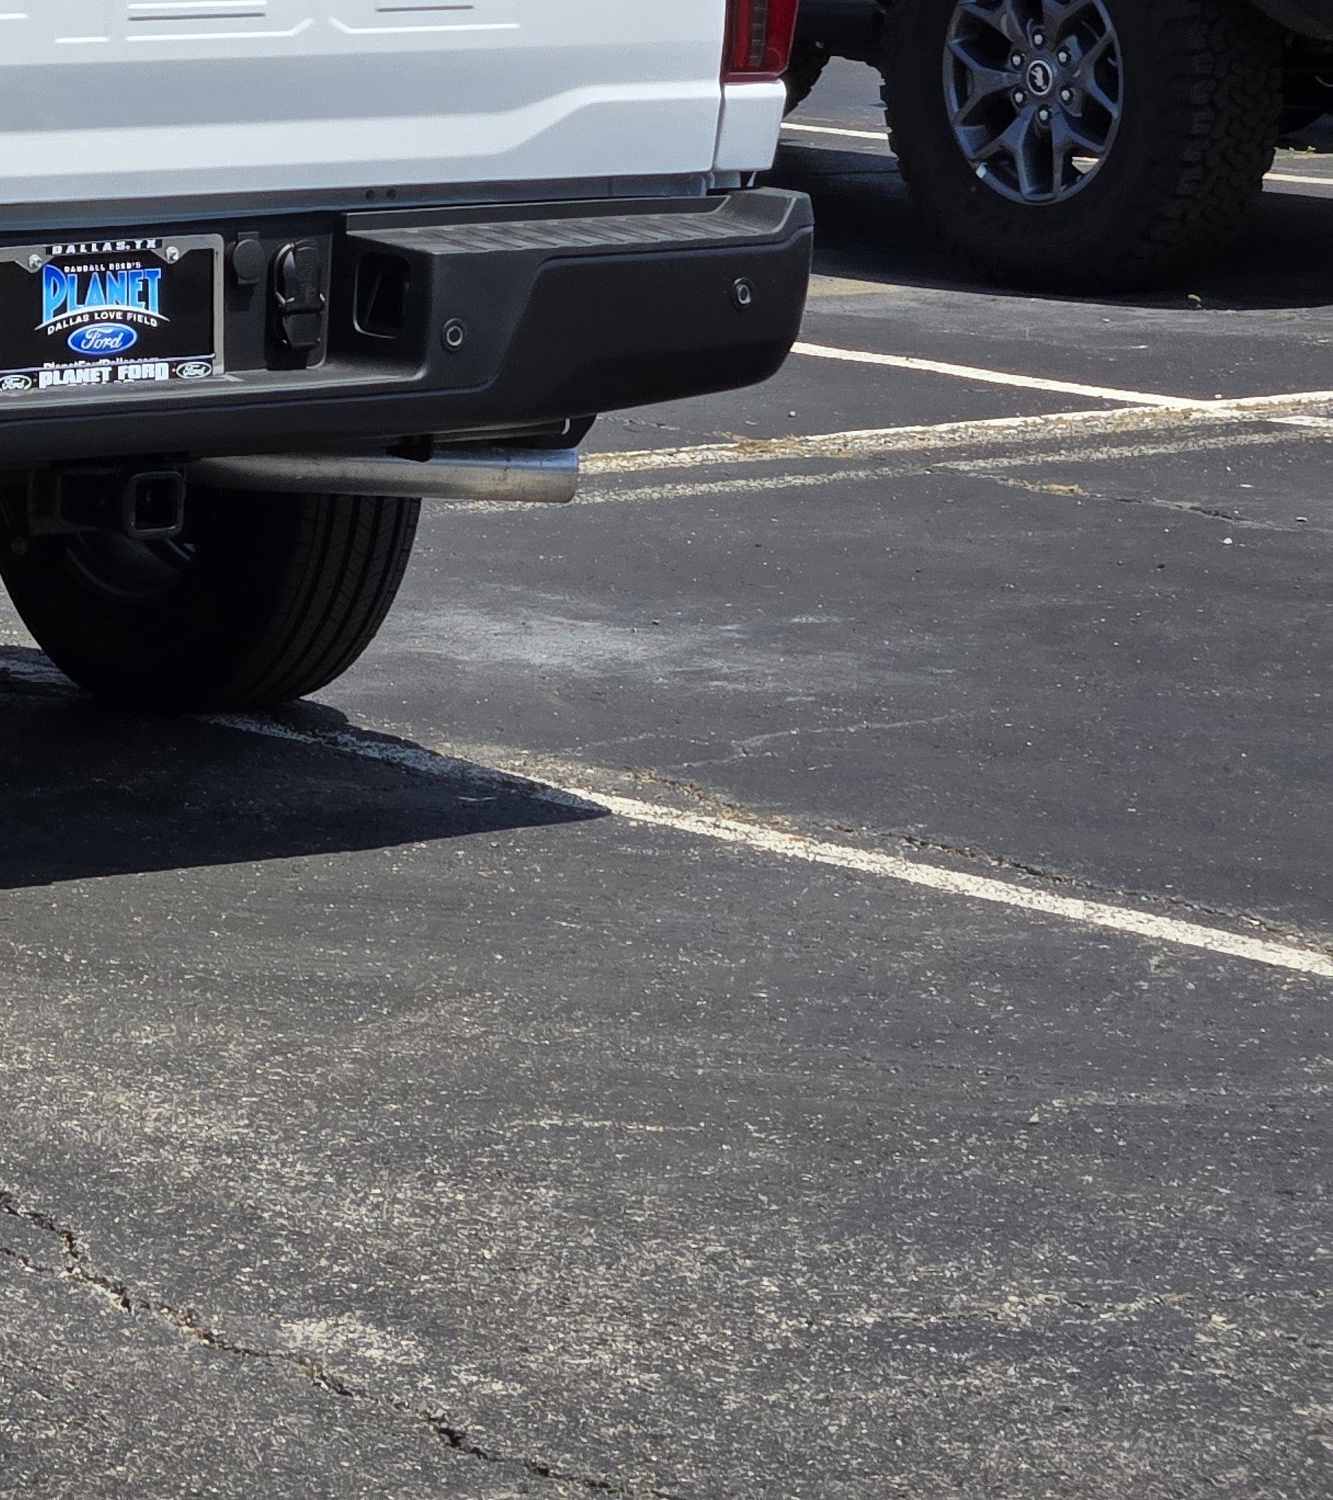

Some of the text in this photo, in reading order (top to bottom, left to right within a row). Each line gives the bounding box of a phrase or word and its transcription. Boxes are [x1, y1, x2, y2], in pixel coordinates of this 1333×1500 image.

[42, 263, 162, 325] PLANET
[47, 310, 159, 336] DALLAS LOVE FIELD
[38, 365, 113, 389] PLANET
[117, 361, 170, 381] FORD
